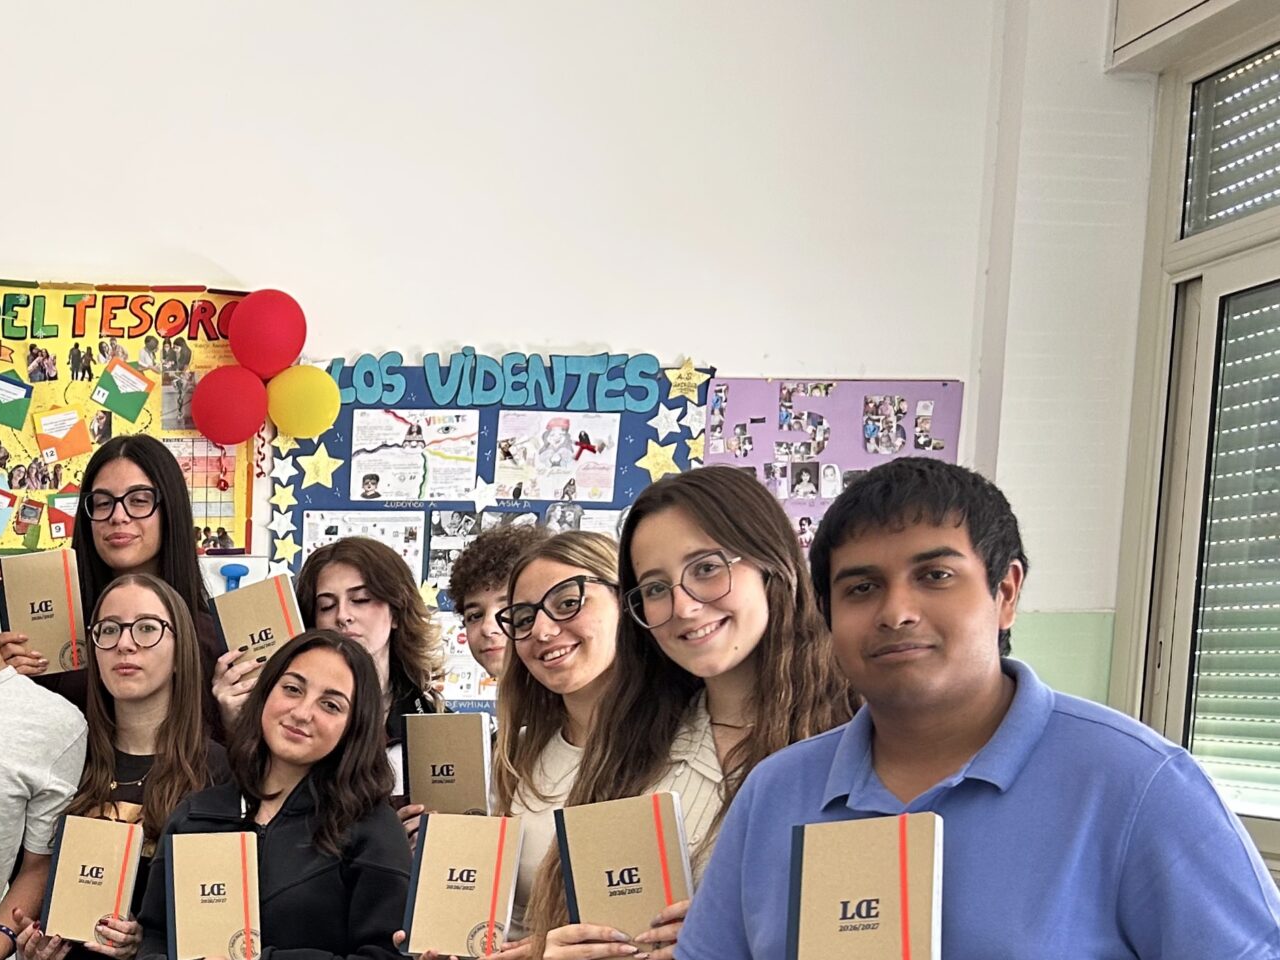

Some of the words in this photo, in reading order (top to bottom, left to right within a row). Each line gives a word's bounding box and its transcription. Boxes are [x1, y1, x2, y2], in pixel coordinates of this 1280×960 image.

[330, 351, 407, 406] LOS
[422, 345, 661, 414] VIDENTES
[95, 389, 107, 400] 11
[44, 450, 56, 459] 12
[54, 525, 62, 534] 9
[838, 923, 880, 932] 2026/2027
